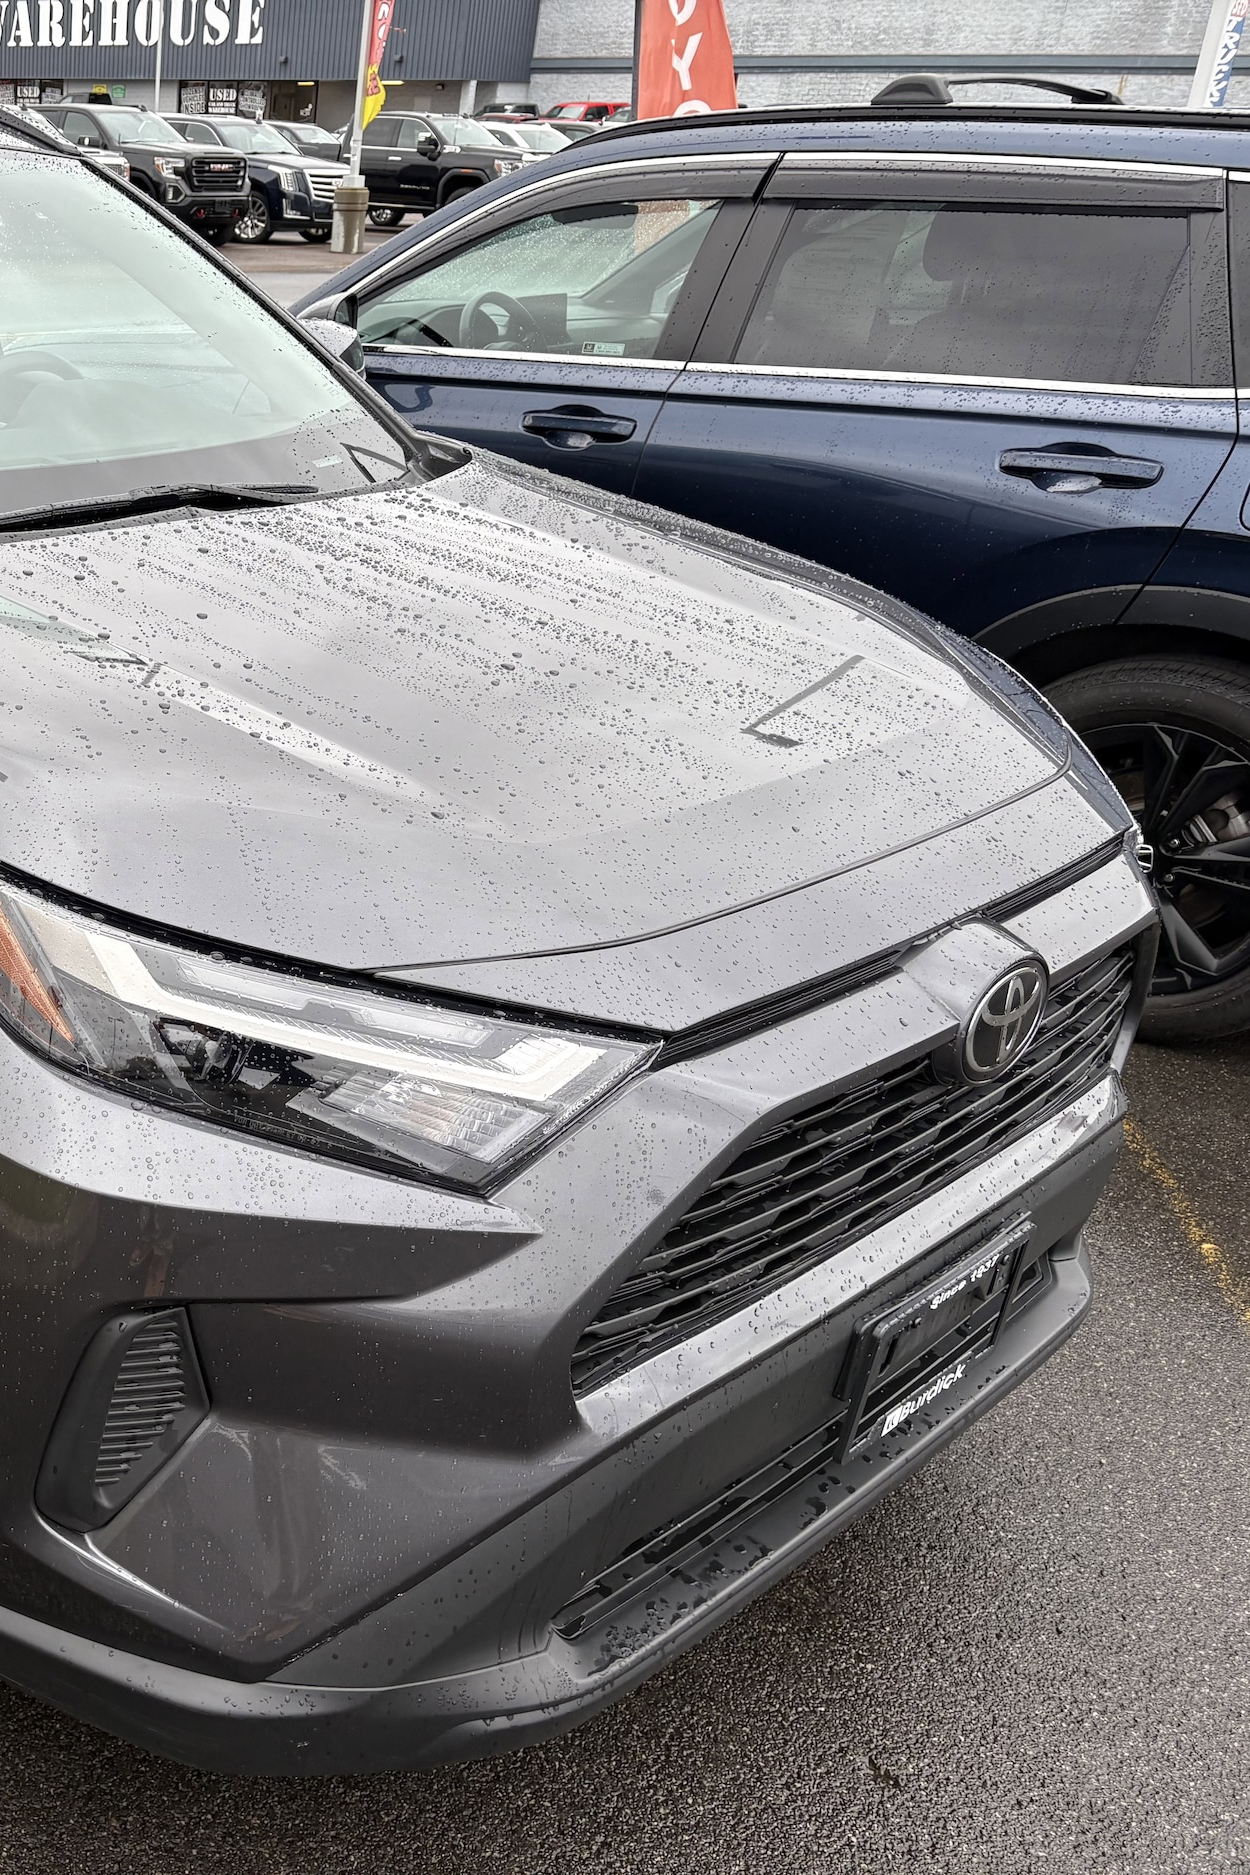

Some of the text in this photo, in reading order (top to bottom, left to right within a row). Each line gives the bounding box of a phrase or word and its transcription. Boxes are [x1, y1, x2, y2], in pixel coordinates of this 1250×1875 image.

[16, 85, 40, 98] USED
[209, 87, 237, 101] USED
[183, 102, 206, 114] INSIDE
[930, 1253, 1000, 1310] Since 1937
[899, 1363, 967, 1423] Burdick
